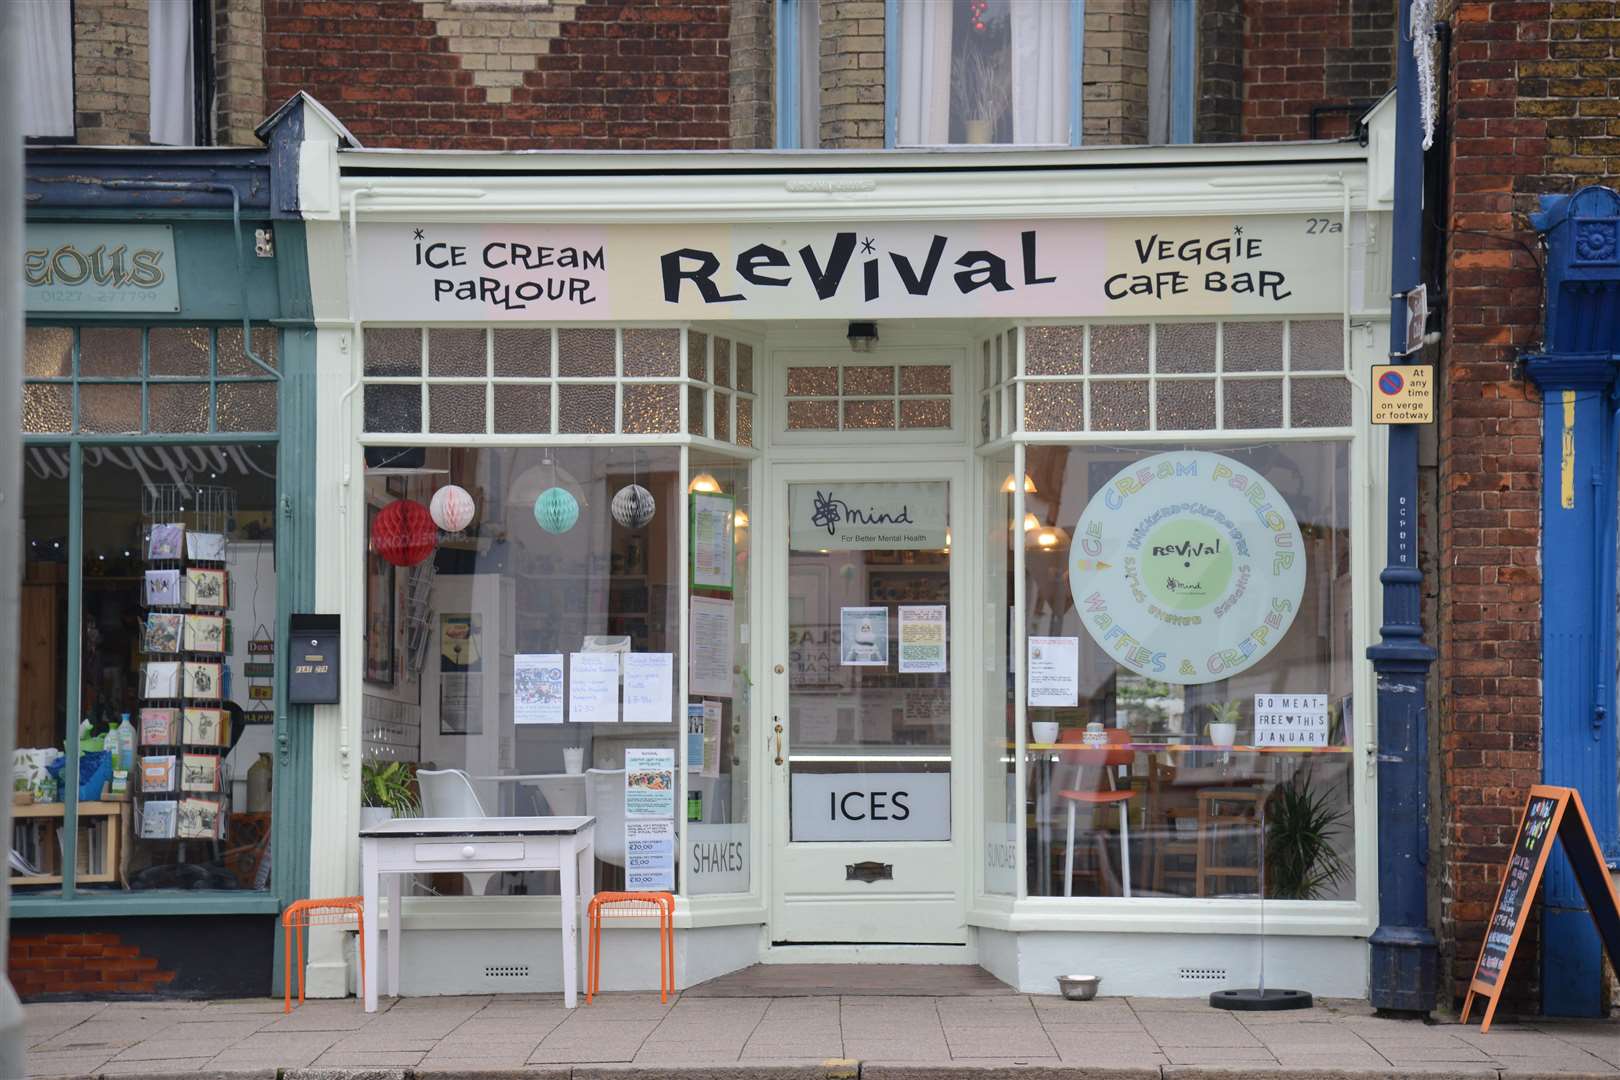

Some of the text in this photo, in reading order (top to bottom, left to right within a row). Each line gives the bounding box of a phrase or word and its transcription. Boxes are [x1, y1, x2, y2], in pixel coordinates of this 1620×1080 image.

[1413, 369, 1424, 377] At
[1410, 380, 1427, 388] any
[1408, 388, 1429, 397] time
[1396, 402, 1423, 410] verge
[1390, 412, 1429, 420] footway
[831, 500, 913, 524] mind
[1258, 698, 1273, 708] GO
[1259, 732, 1325, 743] JANUARY
[831, 791, 910, 821] ICES
[693, 842, 743, 873] SHAKES
